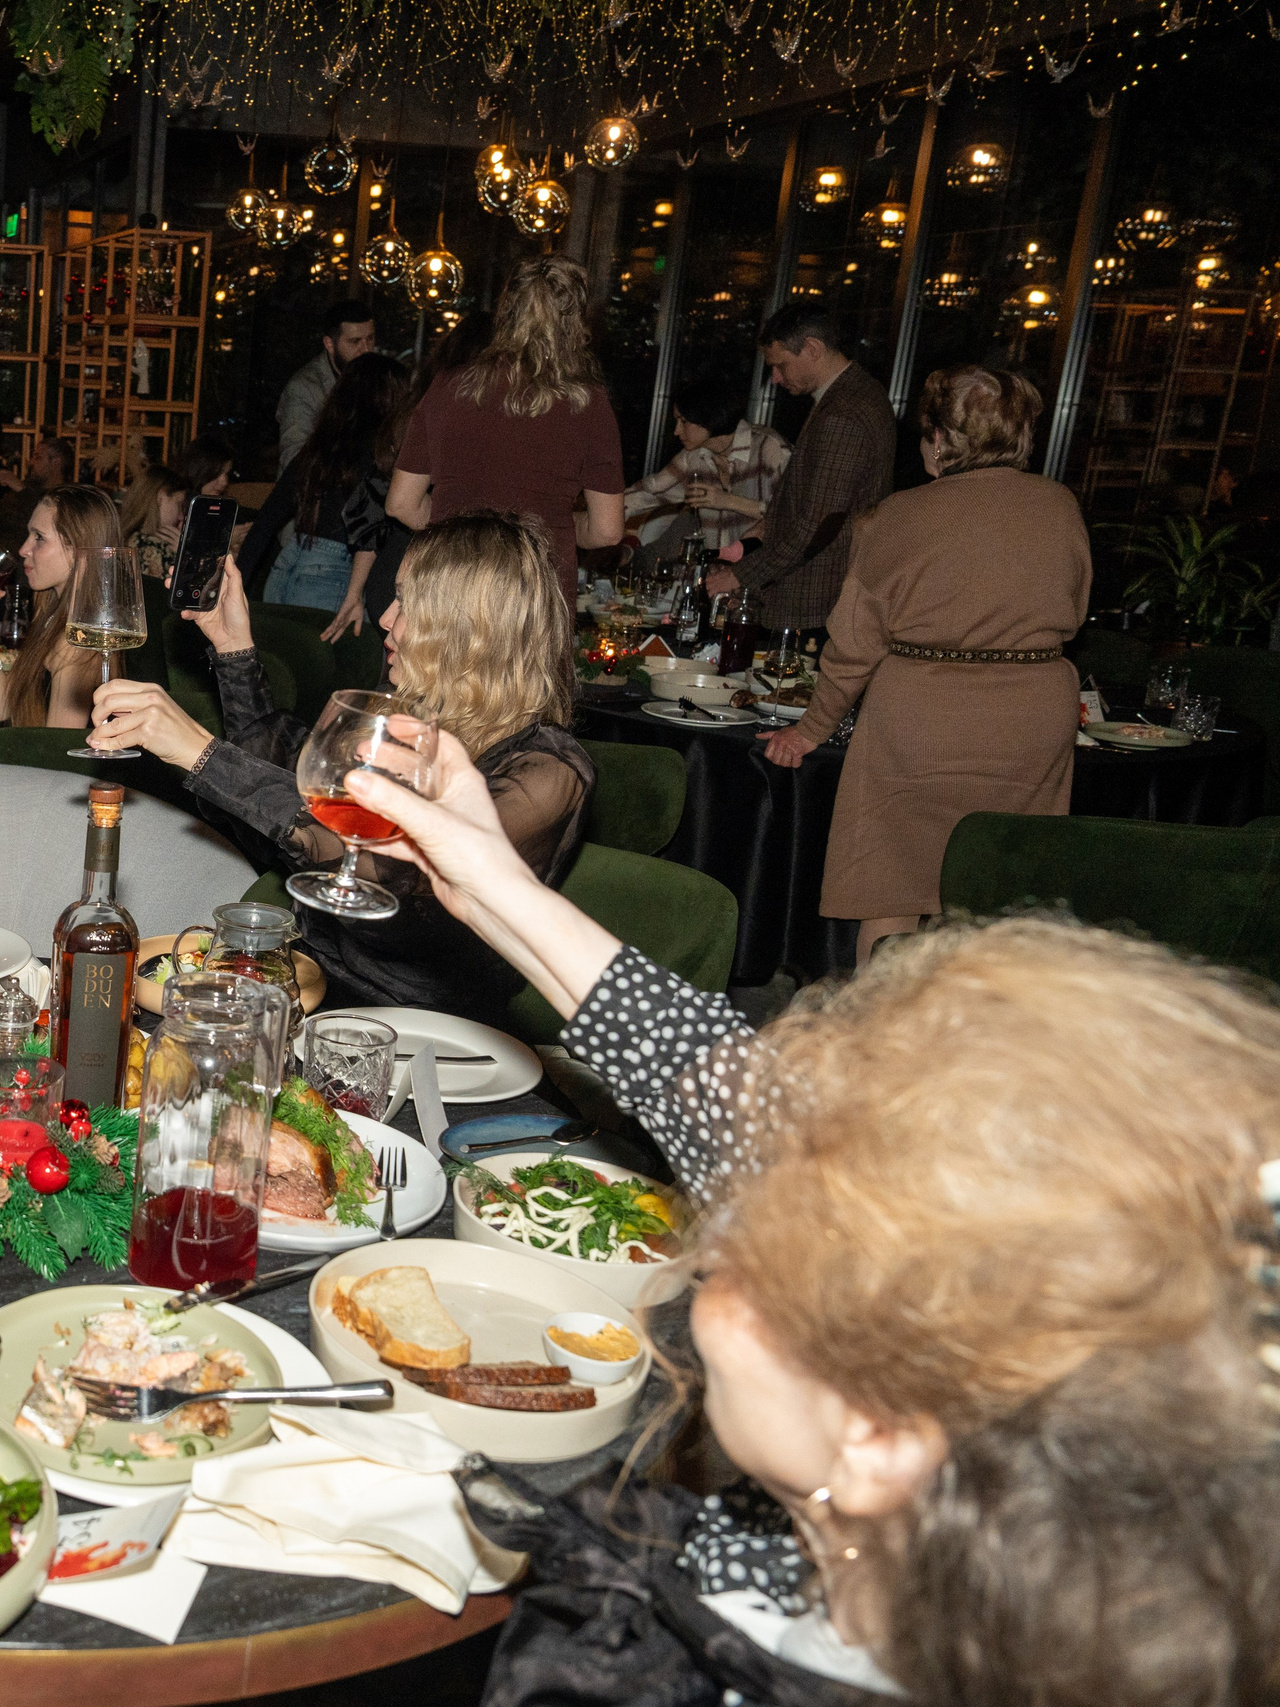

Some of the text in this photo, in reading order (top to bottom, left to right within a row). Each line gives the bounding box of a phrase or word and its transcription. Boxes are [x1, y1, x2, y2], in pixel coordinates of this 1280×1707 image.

[1087, 699, 1099, 709] 25
[85, 963, 114, 979] BO
[84, 978, 113, 994] DU
[83, 993, 111, 1009] EN
